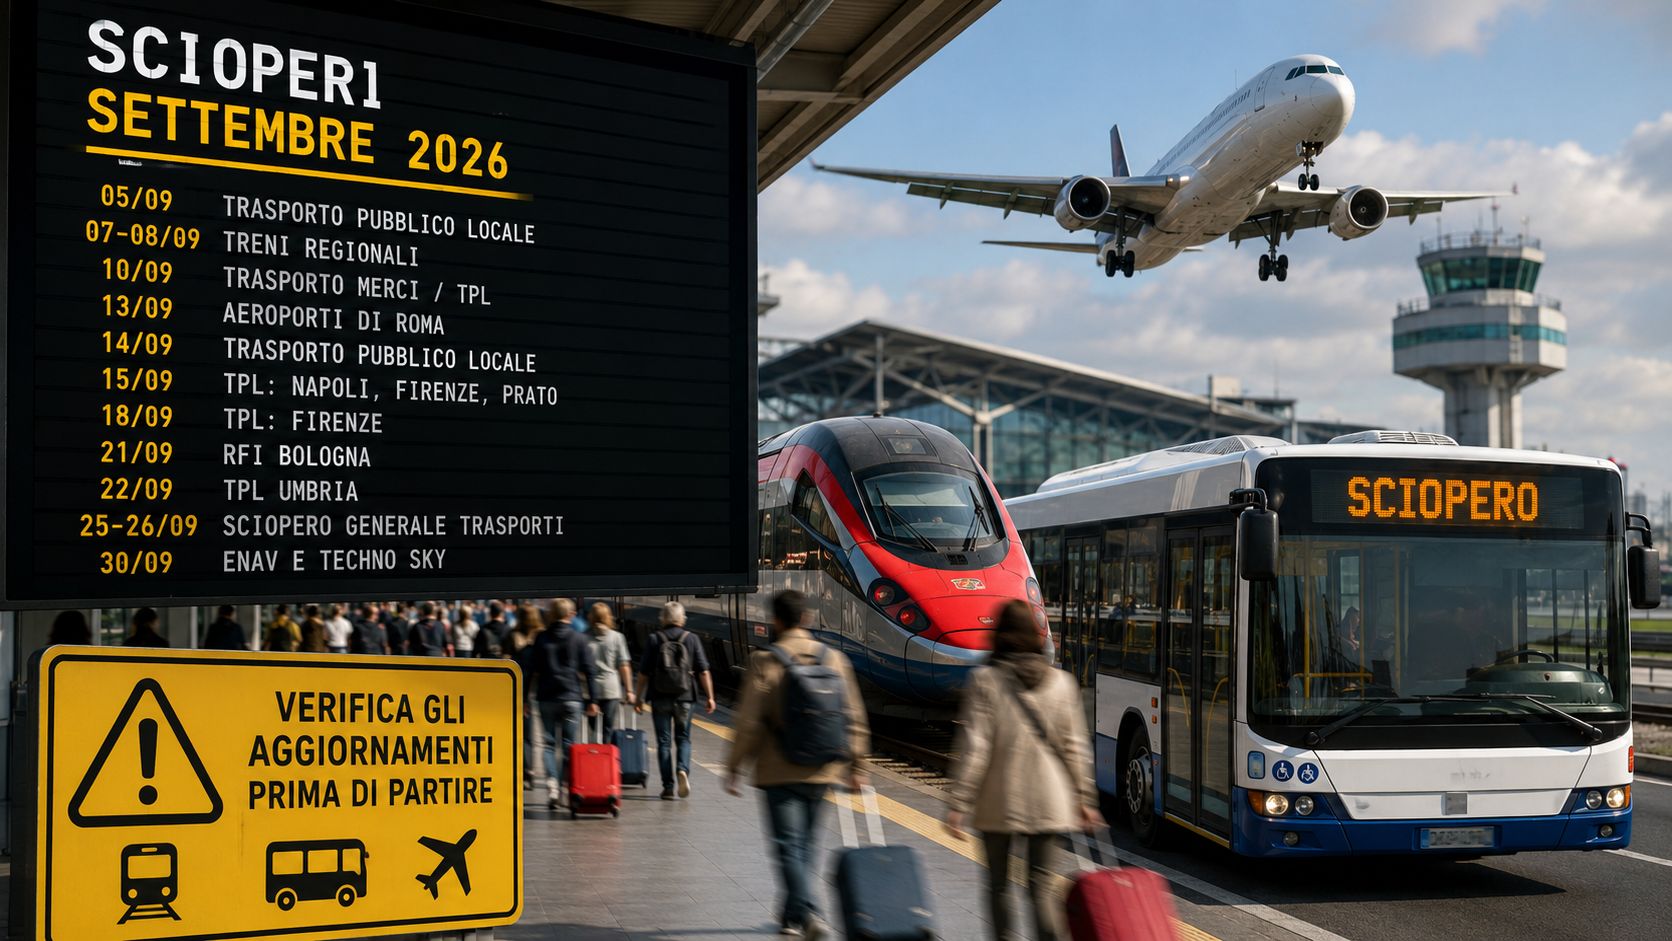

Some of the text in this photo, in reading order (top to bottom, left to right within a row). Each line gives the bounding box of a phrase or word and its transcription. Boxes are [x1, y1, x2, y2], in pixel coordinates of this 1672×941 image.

[86, 87, 509, 180] SETTEMBRE 2026
[101, 183, 535, 244] 05/09 TRASPORTO PUBBLICO LOCALE
[85, 219, 419, 267] 07-08/09 TRENI REGIONALI
[102, 257, 491, 306] 10/09 TRASPORTO MERCI / TPL
[102, 294, 445, 336] 13/09 AEROPORTI DI ROMA
[102, 330, 537, 373] 14/09 TRASPORTO PUBBLICO LOCALE
[102, 367, 558, 406] 15/09 TPL: NAPOLI, FIRENZE, PRATO
[102, 403, 383, 434] 18/09 TPL: FIRENZE
[100, 440, 372, 468] 21/09 RFI BOLOGNA
[100, 476, 359, 502] 22/09 TPL UMBRIA
[1348, 476, 1539, 522] SCIOPERO
[79, 513, 564, 538] 25-26/09 SCIOPERO GENERALE TRASPORTI
[99, 548, 446, 575] 30/09 ENAV E TECHNO SKY
[275, 691, 465, 724] VERIFICA GLI
[248, 734, 494, 767] AGGIORNAMENTI
[249, 777, 493, 810] PRIMA DI PARTIRE
